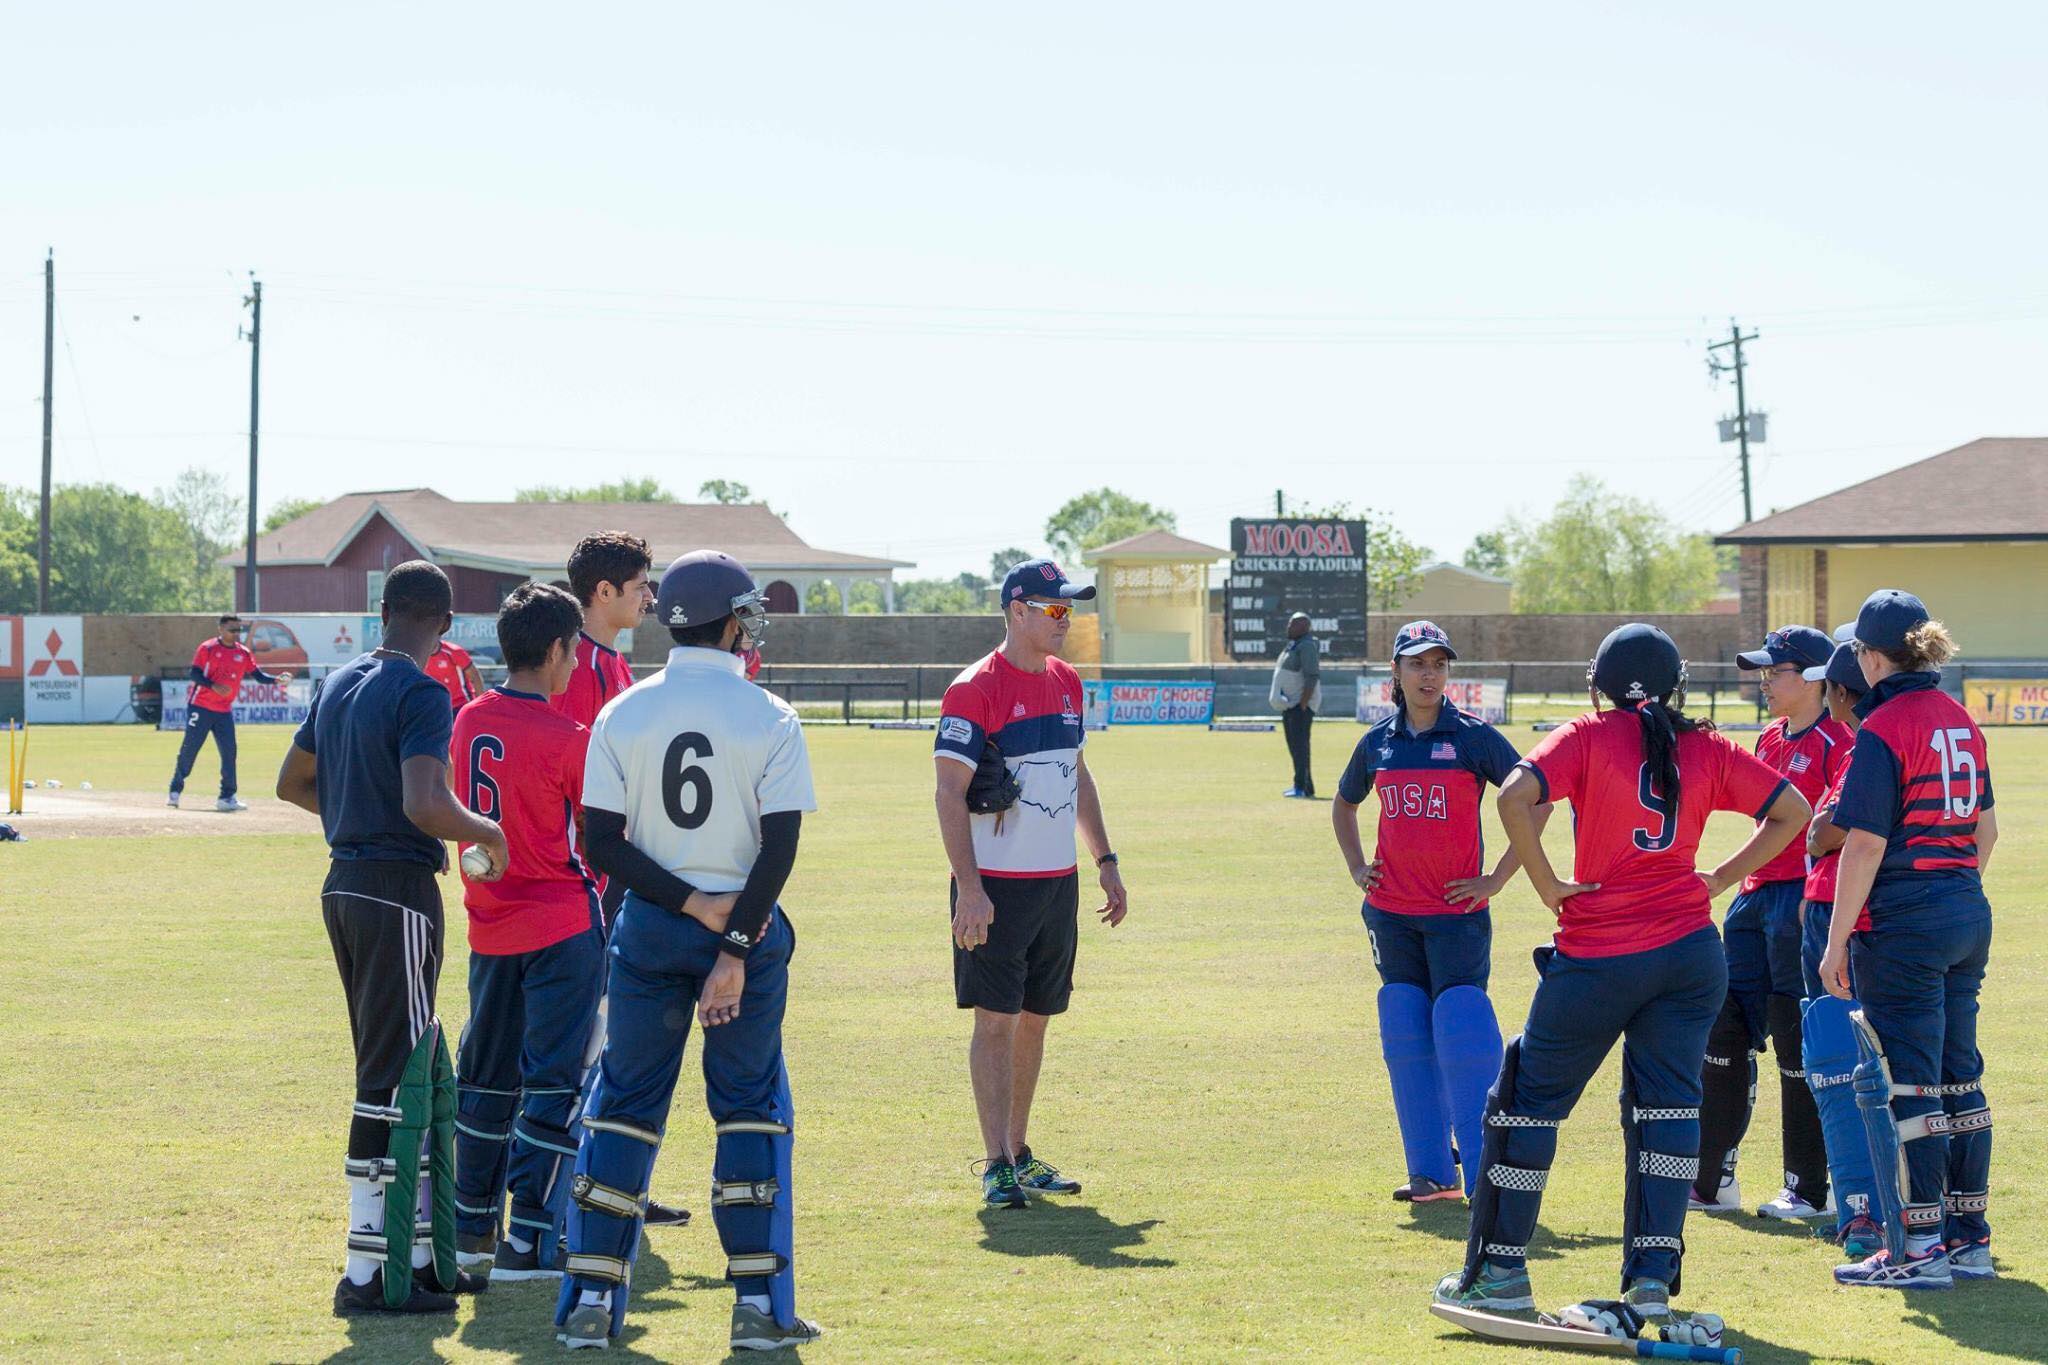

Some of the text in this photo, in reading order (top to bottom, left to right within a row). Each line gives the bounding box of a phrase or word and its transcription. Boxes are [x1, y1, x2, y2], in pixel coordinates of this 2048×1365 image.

[1244, 524, 1354, 557] MOOSA
[1234, 558, 1363, 571] CRICKET STADIUM
[1233, 618, 1339, 632] TOTAL VERS
[1112, 687, 1214, 702] SMART CHOICE
[188, 712, 199, 727] 2
[1114, 705, 1207, 720] AUTO GROUP
[469, 734, 504, 824] 6
[662, 731, 714, 830] 6
[1929, 728, 1977, 820] 15
[1380, 783, 1447, 820] USA
